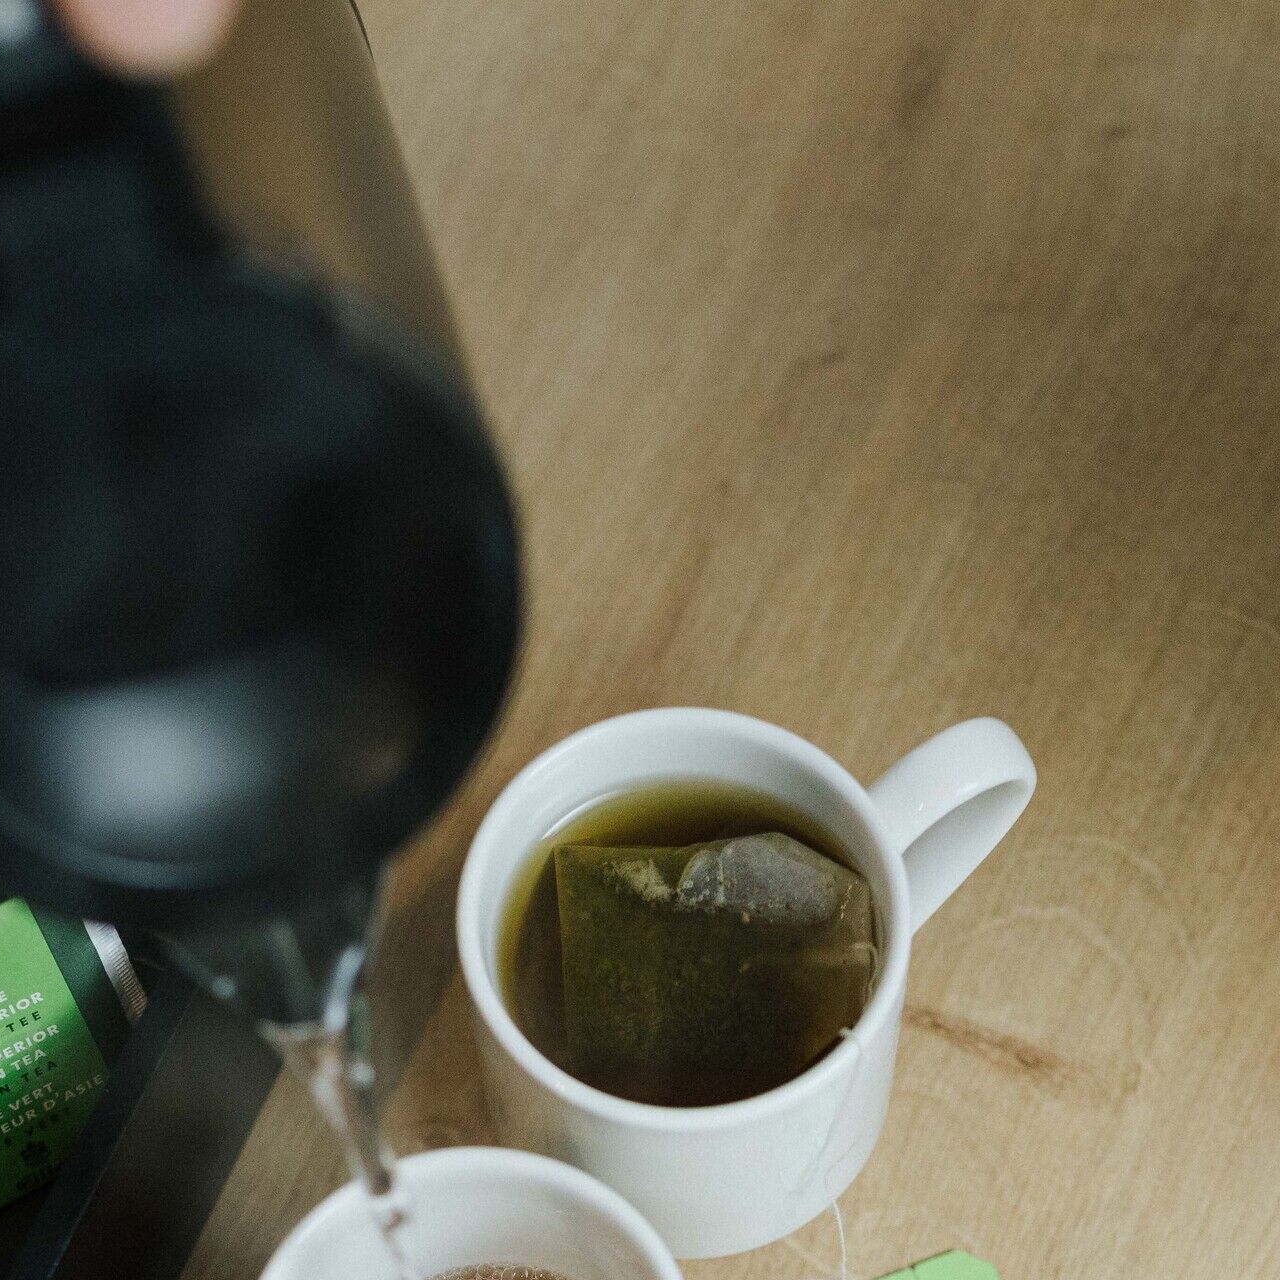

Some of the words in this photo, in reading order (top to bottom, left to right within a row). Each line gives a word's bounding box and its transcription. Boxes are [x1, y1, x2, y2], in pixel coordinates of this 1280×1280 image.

[6, 1010, 41, 1034] TEE
[9, 1046, 47, 1073] TEA
[21, 1058, 59, 1084] TEA
[7, 1081, 56, 1114] VERT
